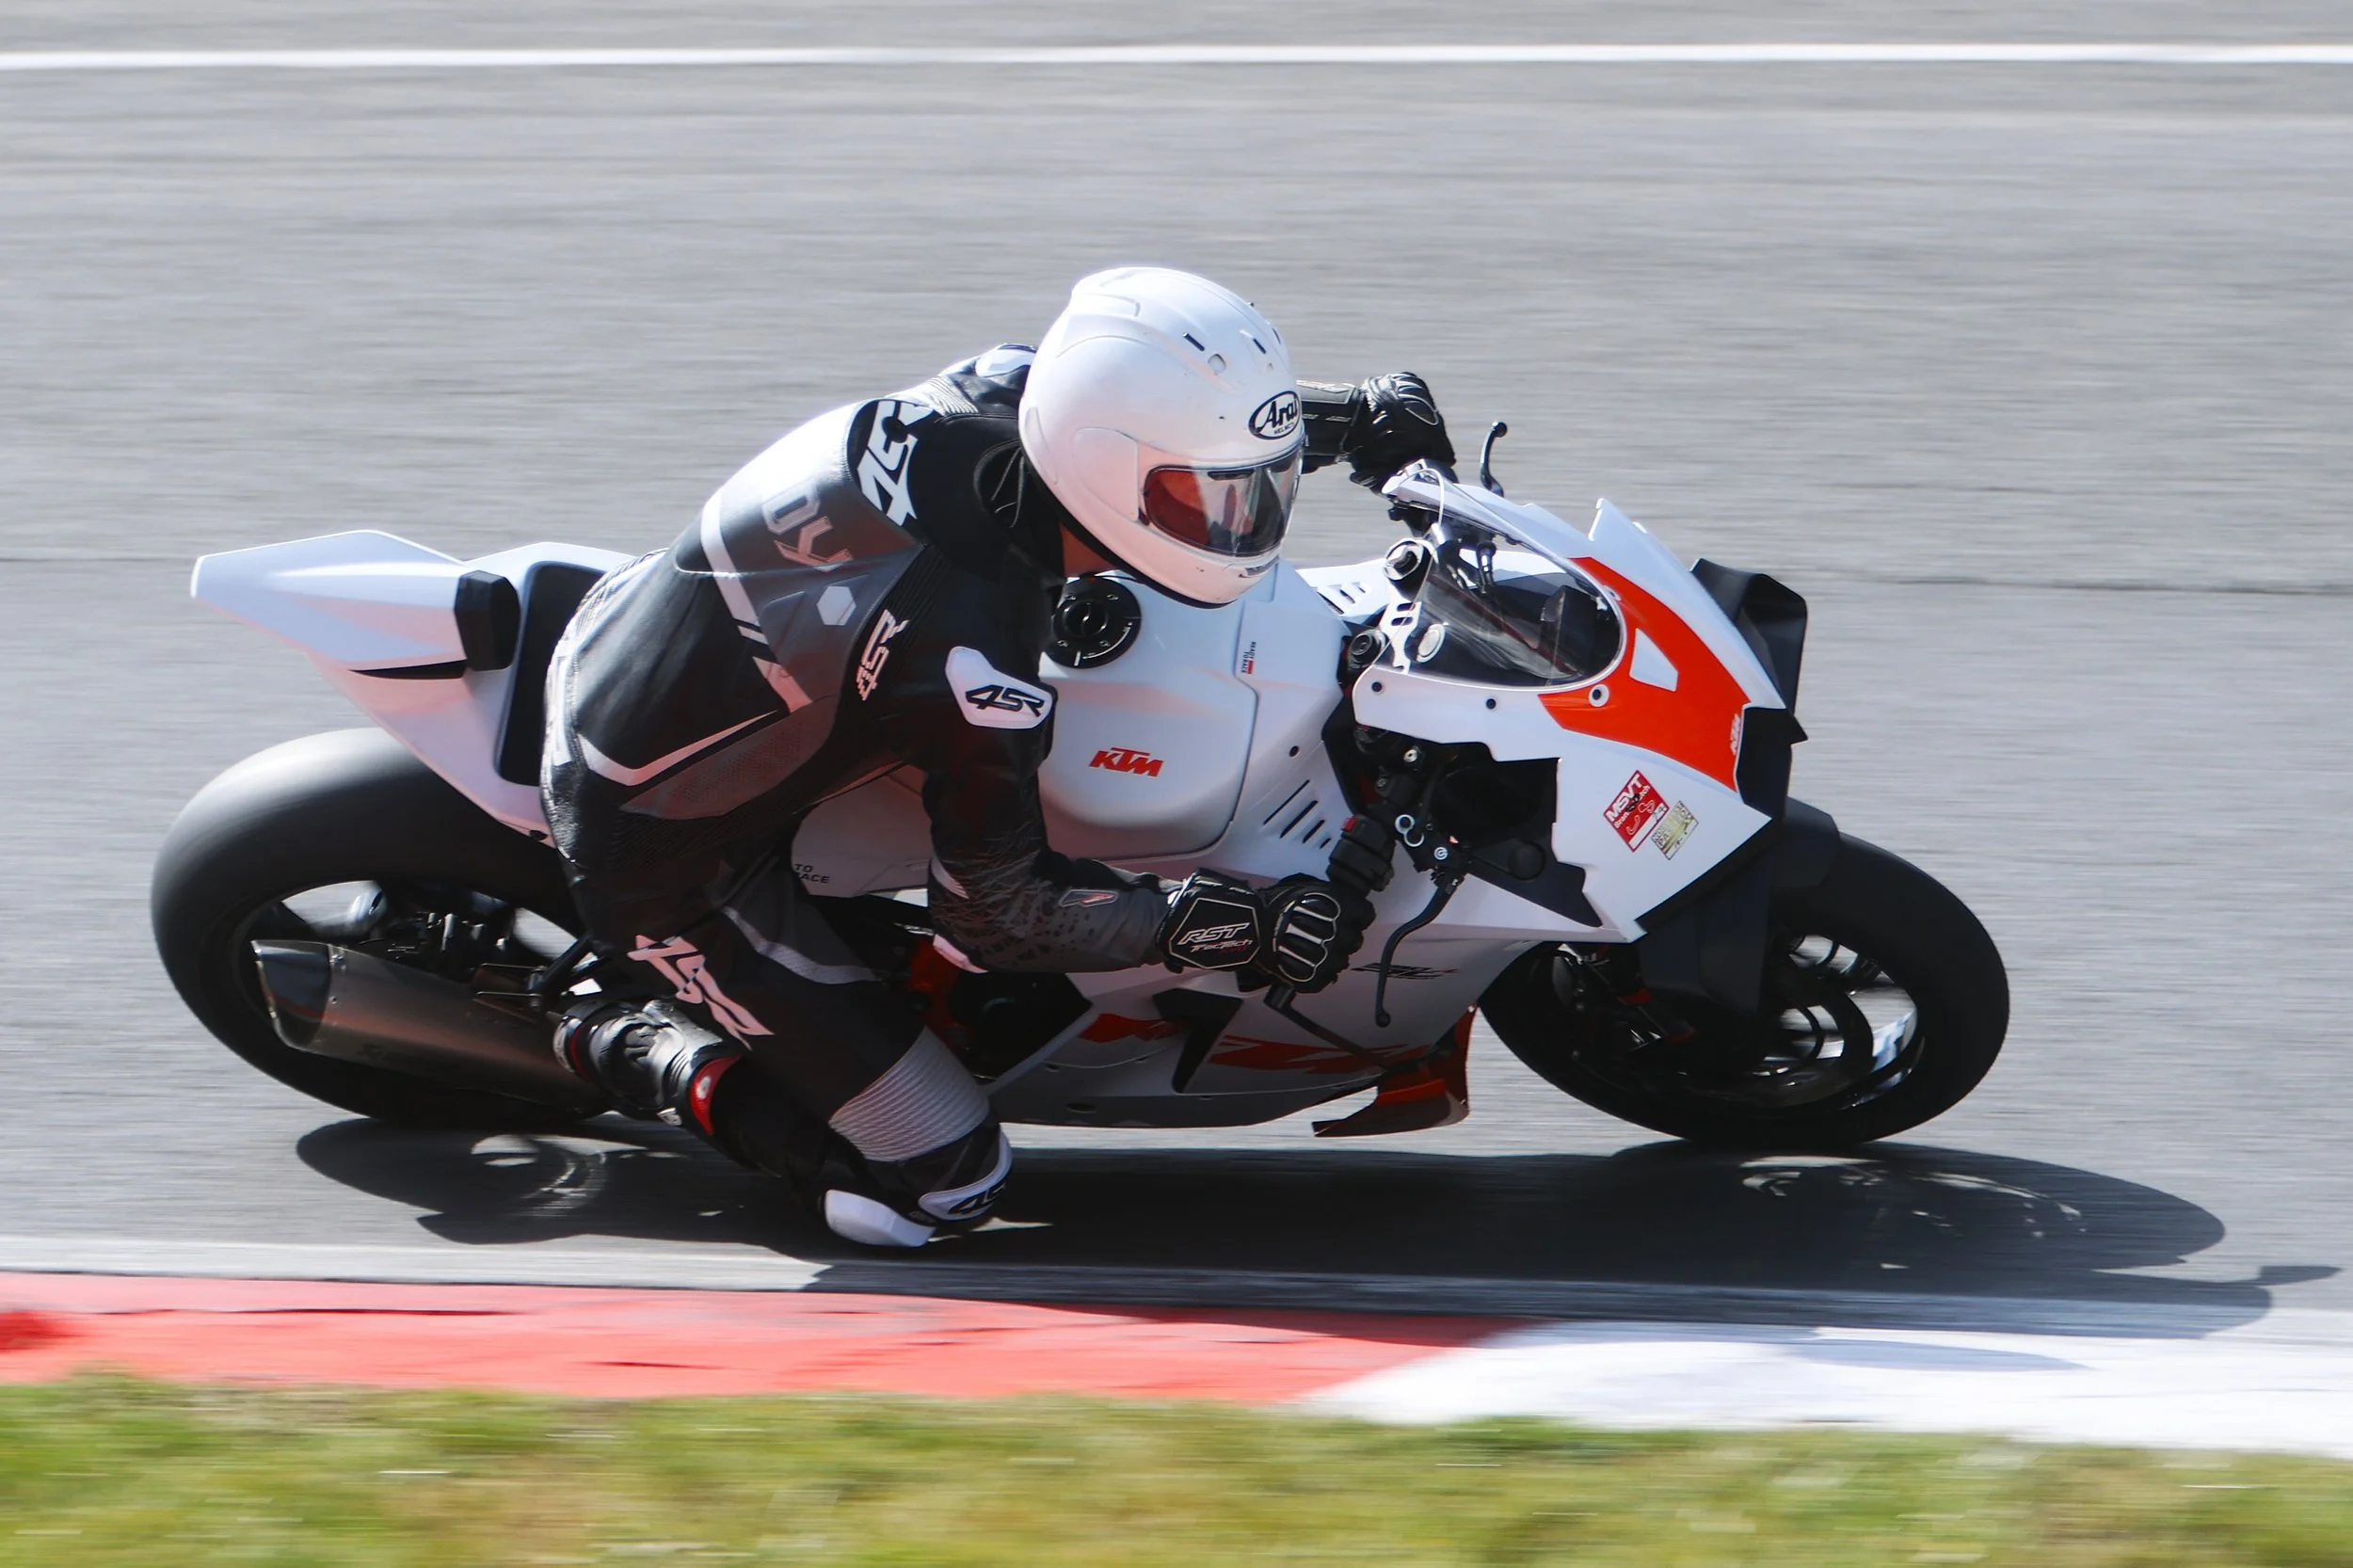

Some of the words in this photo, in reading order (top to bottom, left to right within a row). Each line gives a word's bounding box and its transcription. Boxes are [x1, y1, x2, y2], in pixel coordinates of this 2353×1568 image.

[856, 609, 910, 701] 4SR
[965, 684, 1045, 717] 4SR
[1089, 746, 1164, 777] KTM
[1605, 774, 1642, 823] MSVT
[793, 863, 814, 873] TO
[798, 872, 830, 884] ACE
[1176, 922, 1250, 946] RST
